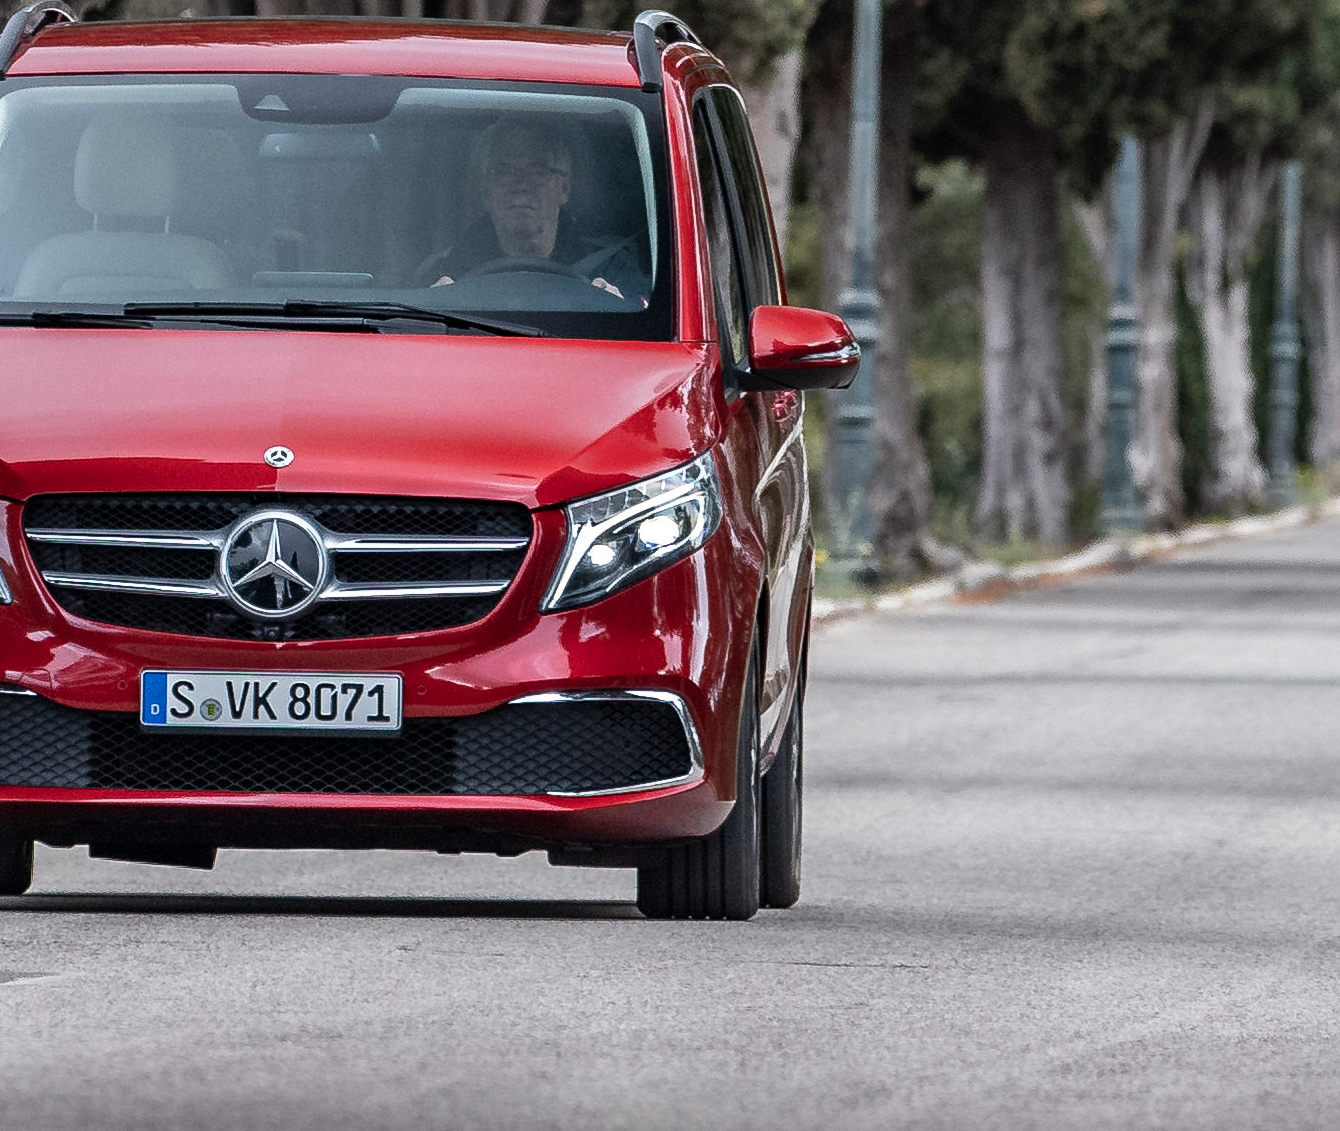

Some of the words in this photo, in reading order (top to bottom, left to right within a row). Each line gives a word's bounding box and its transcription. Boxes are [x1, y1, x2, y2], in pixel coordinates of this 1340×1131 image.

[150, 703, 160, 715] D
[170, 681, 195, 719] S
[225, 681, 278, 721] VK
[287, 682, 391, 722] 8071
